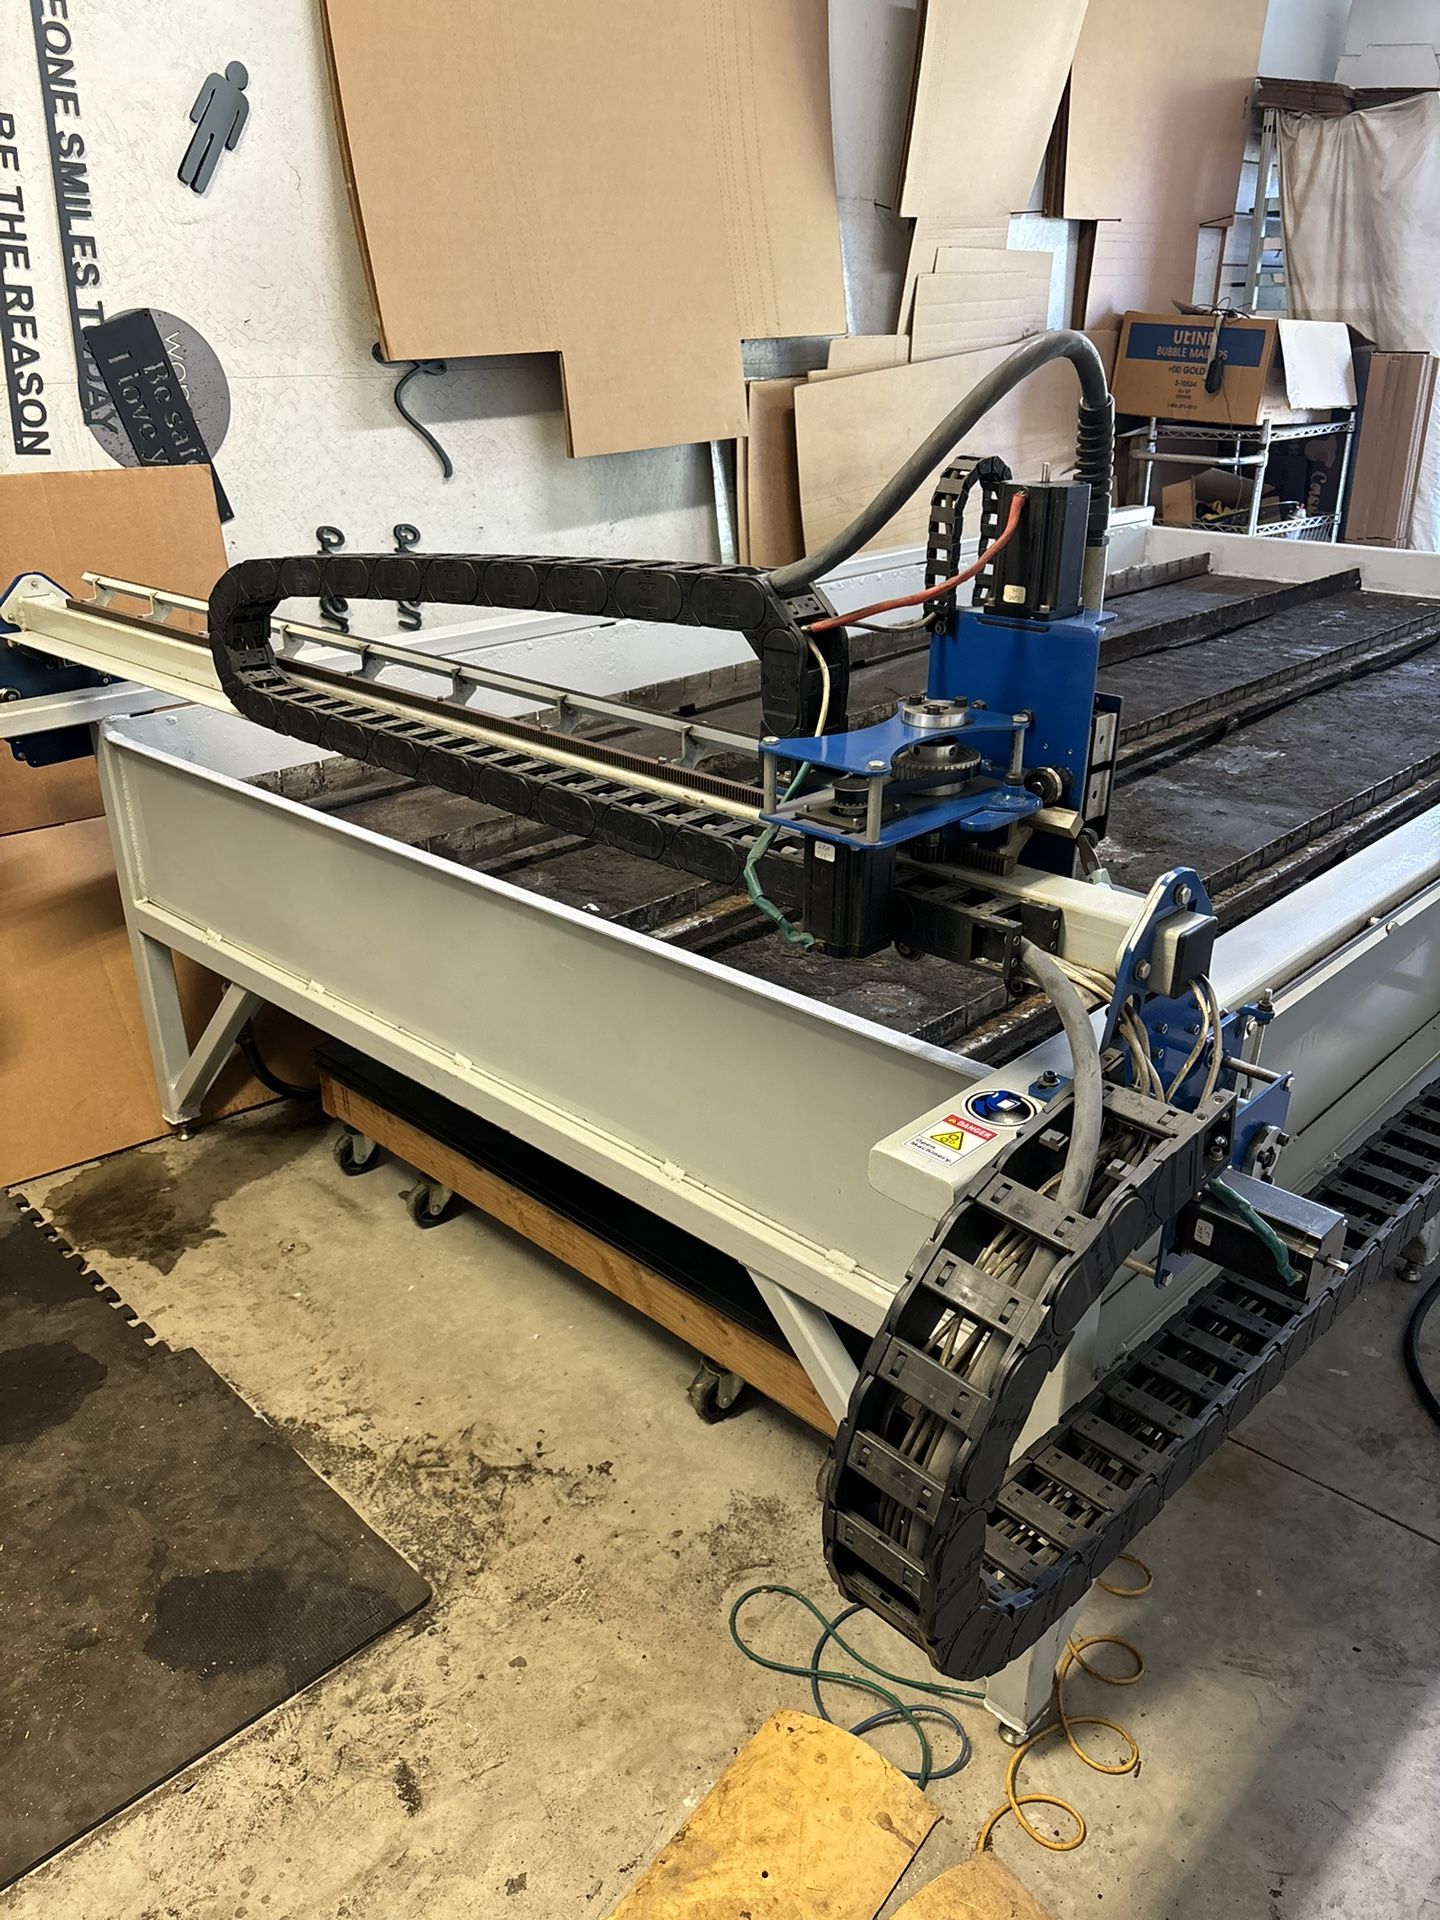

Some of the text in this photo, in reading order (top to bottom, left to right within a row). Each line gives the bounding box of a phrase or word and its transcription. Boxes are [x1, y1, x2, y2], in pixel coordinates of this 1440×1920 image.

[57, 130, 100, 287] SMILES
[0, 186, 31, 270] THE
[1156, 346, 1188, 358] BUBBLE
[5, 284, 51, 455] REASON
[143, 361, 172, 403] Be
[1183, 366, 1206, 375] GOLD
[916, 1138, 936, 1149] Open
[957, 1120, 993, 1139] DANGER
